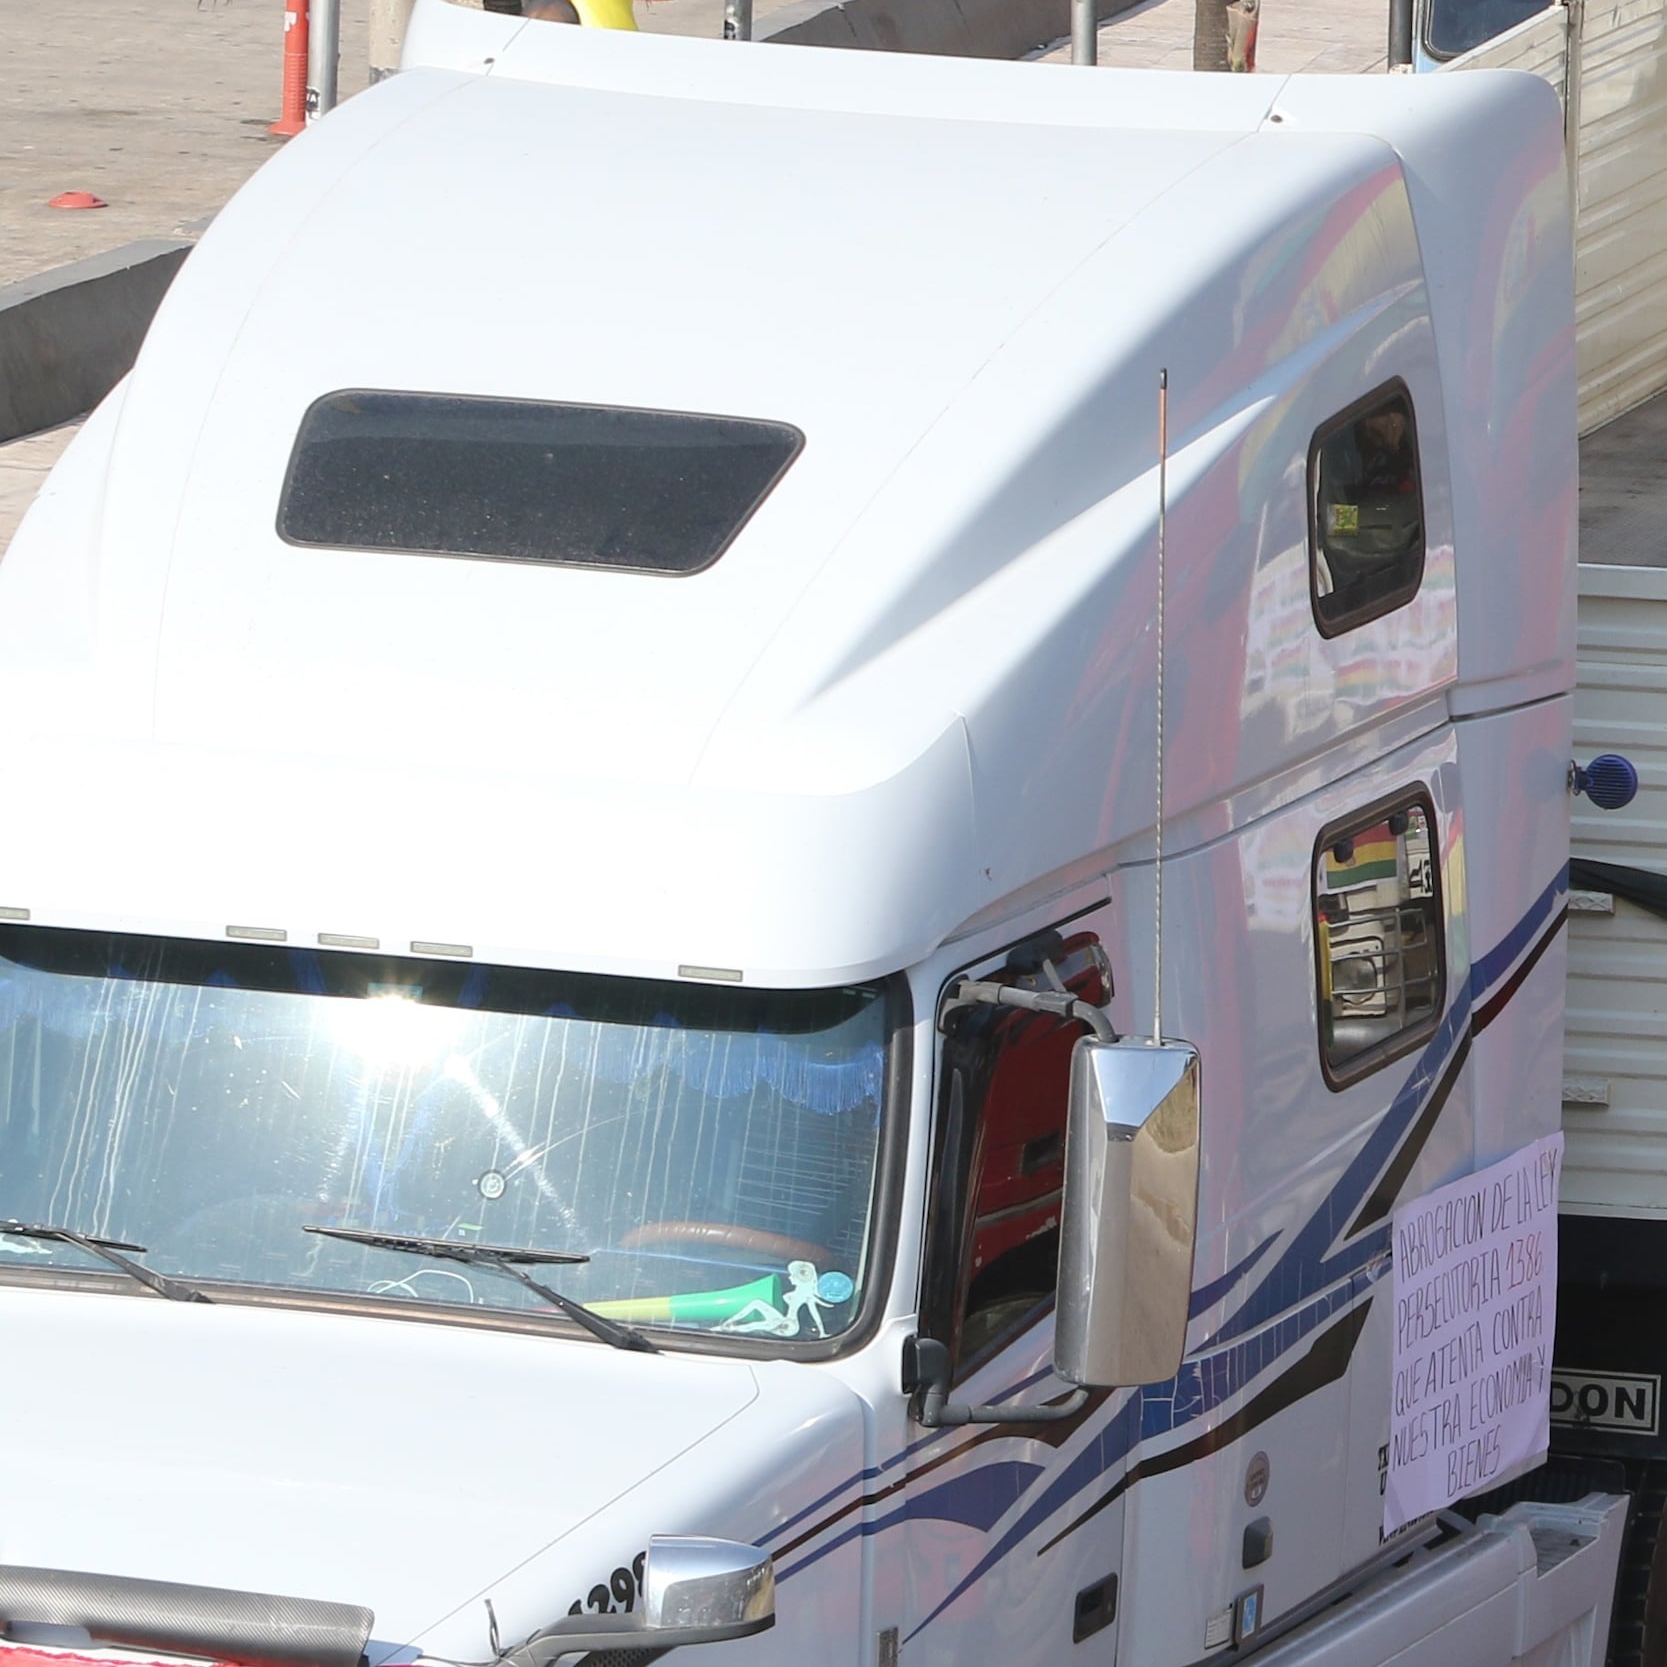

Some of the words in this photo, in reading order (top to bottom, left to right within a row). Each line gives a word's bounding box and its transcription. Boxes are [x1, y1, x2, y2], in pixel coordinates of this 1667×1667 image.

[1399, 1191, 1486, 1283] ABROGACION
[1490, 1181, 1513, 1231] DE
[1515, 1167, 1533, 1226] LA
[1533, 1147, 1560, 1214] LEY
[1505, 1230, 1544, 1291] 1386
[1394, 1357, 1423, 1417] QUE
[1424, 1320, 1485, 1399] ATENTA
[1492, 1285, 1544, 1356] CONTRA
[1391, 1392, 1462, 1471] NUESTRA
[1446, 1423, 1503, 1498] BIENES
